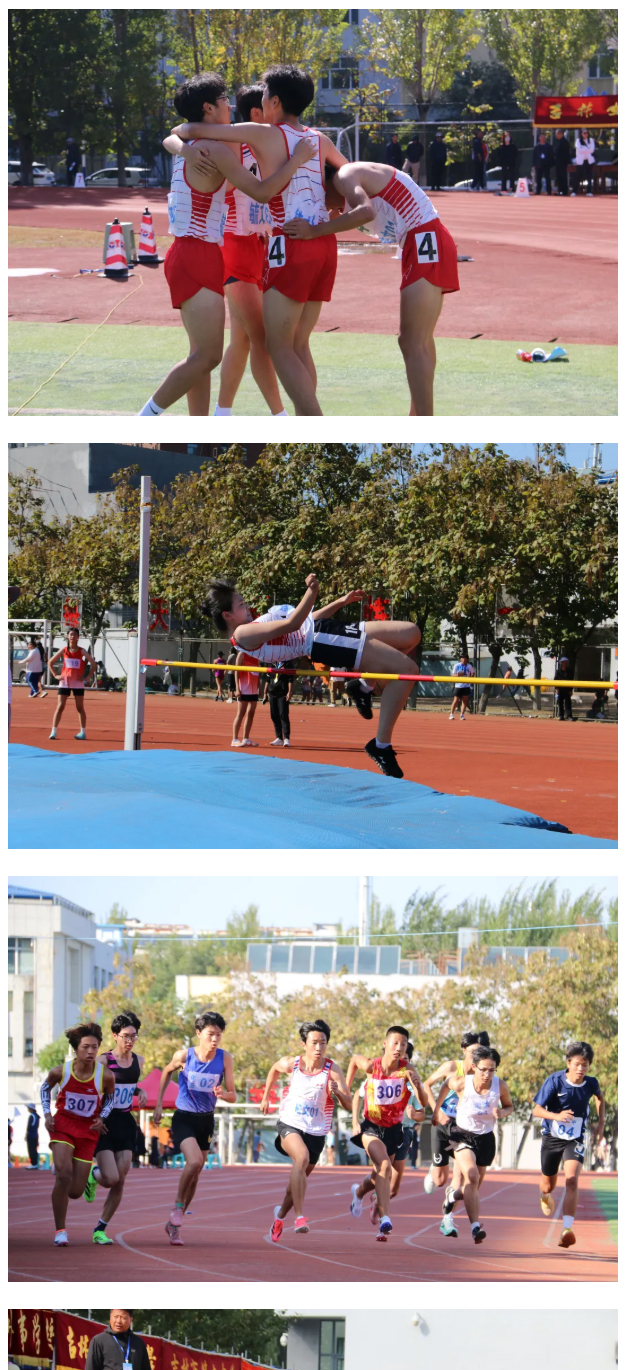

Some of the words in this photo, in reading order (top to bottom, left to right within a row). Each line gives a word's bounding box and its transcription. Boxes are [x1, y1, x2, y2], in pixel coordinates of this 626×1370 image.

[519, 182, 525, 193] 5
[268, 236, 285, 265] 4
[418, 233, 437, 261] 4
[200, 1077, 215, 1089] 02
[376, 1084, 402, 1099] 306
[67, 1097, 95, 1112] 307
[557, 1124, 574, 1137] 04
